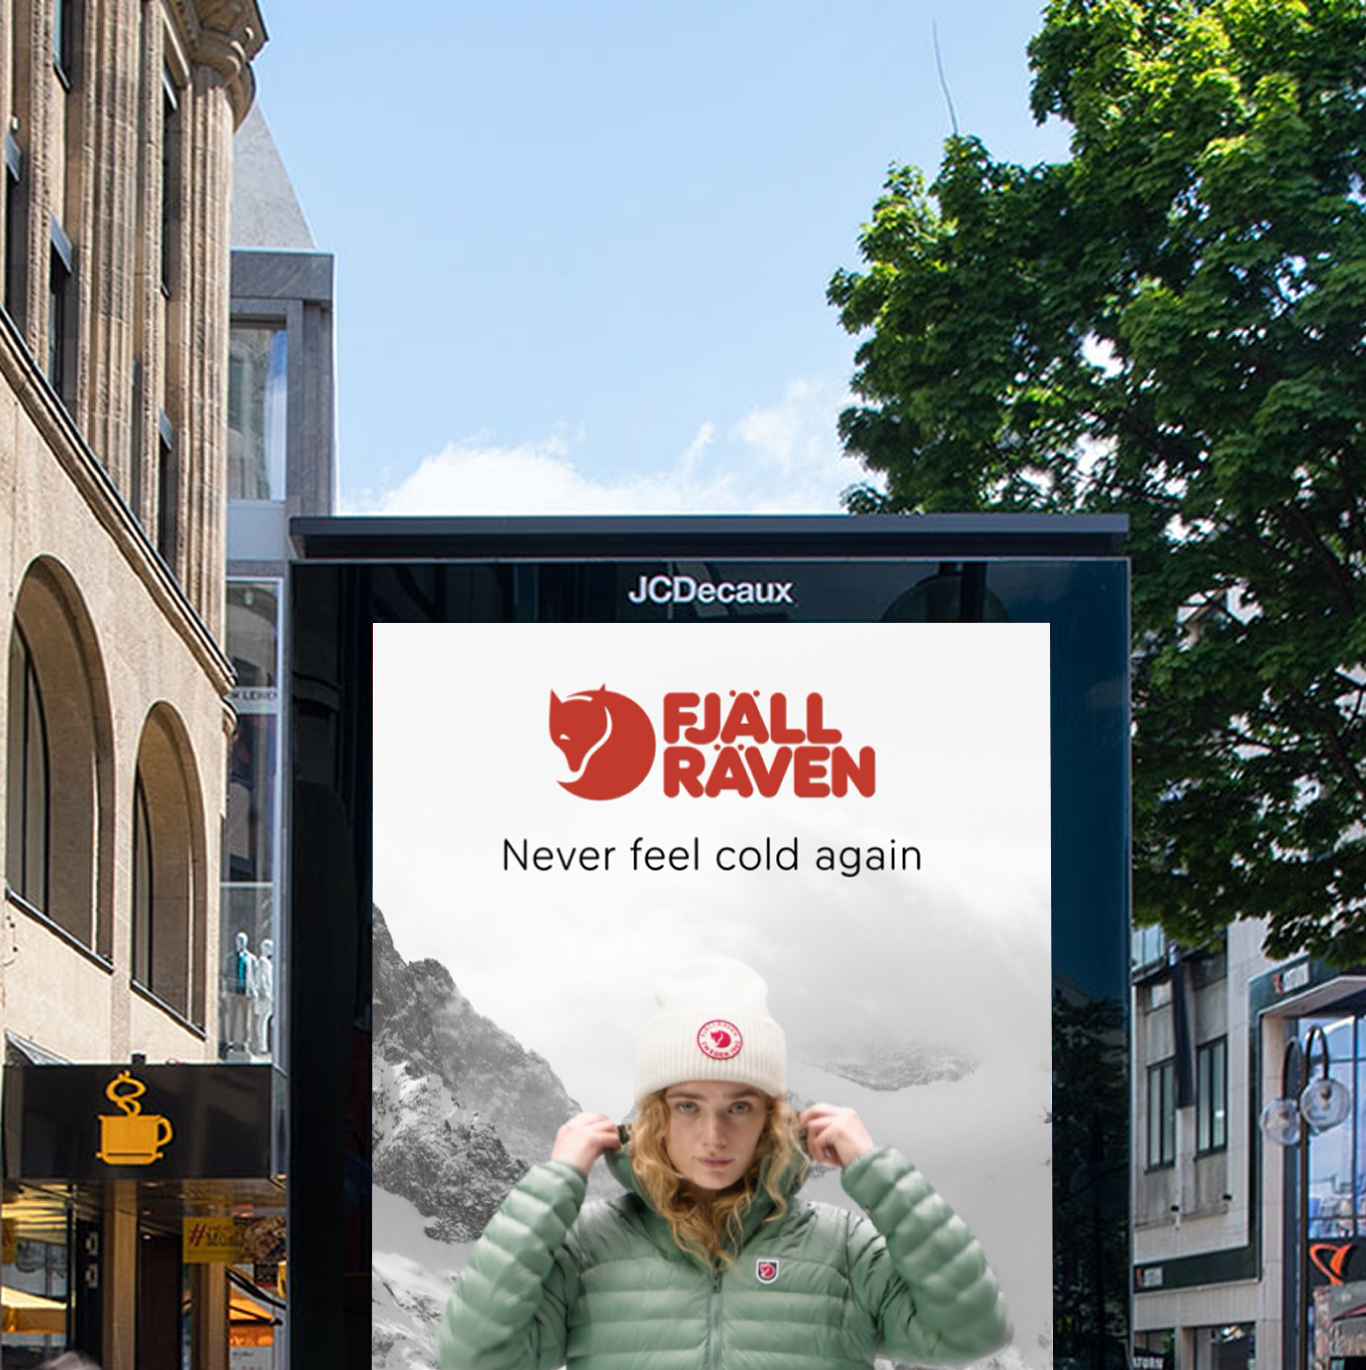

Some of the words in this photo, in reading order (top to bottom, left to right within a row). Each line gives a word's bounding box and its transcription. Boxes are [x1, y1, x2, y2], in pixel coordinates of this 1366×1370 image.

[628, 575, 793, 604] JCDecaux
[663, 690, 843, 745] FJÄLL
[663, 744, 876, 798] RÄVEN
[503, 838, 616, 872] Never
[630, 836, 699, 871] feel
[716, 836, 798, 871] cold
[815, 839, 921, 878] again
